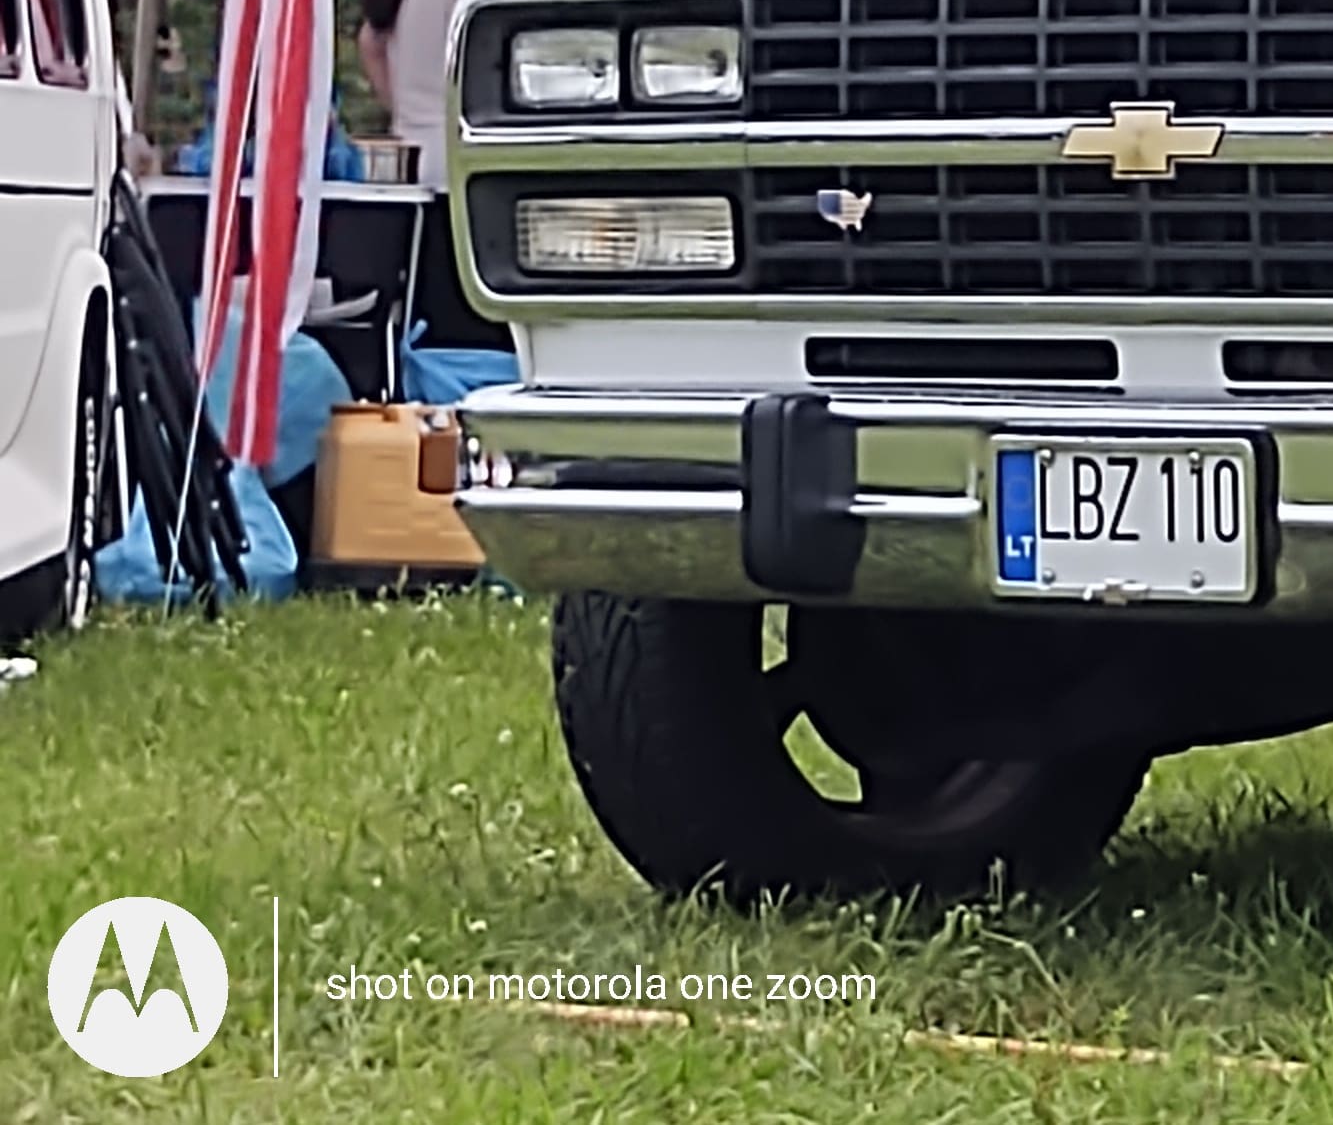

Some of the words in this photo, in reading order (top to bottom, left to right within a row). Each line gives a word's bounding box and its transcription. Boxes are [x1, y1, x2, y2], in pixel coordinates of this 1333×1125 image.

[1040, 456, 1140, 541] LBZ
[1159, 456, 1240, 544] 110
[1006, 535, 1034, 558] LT
